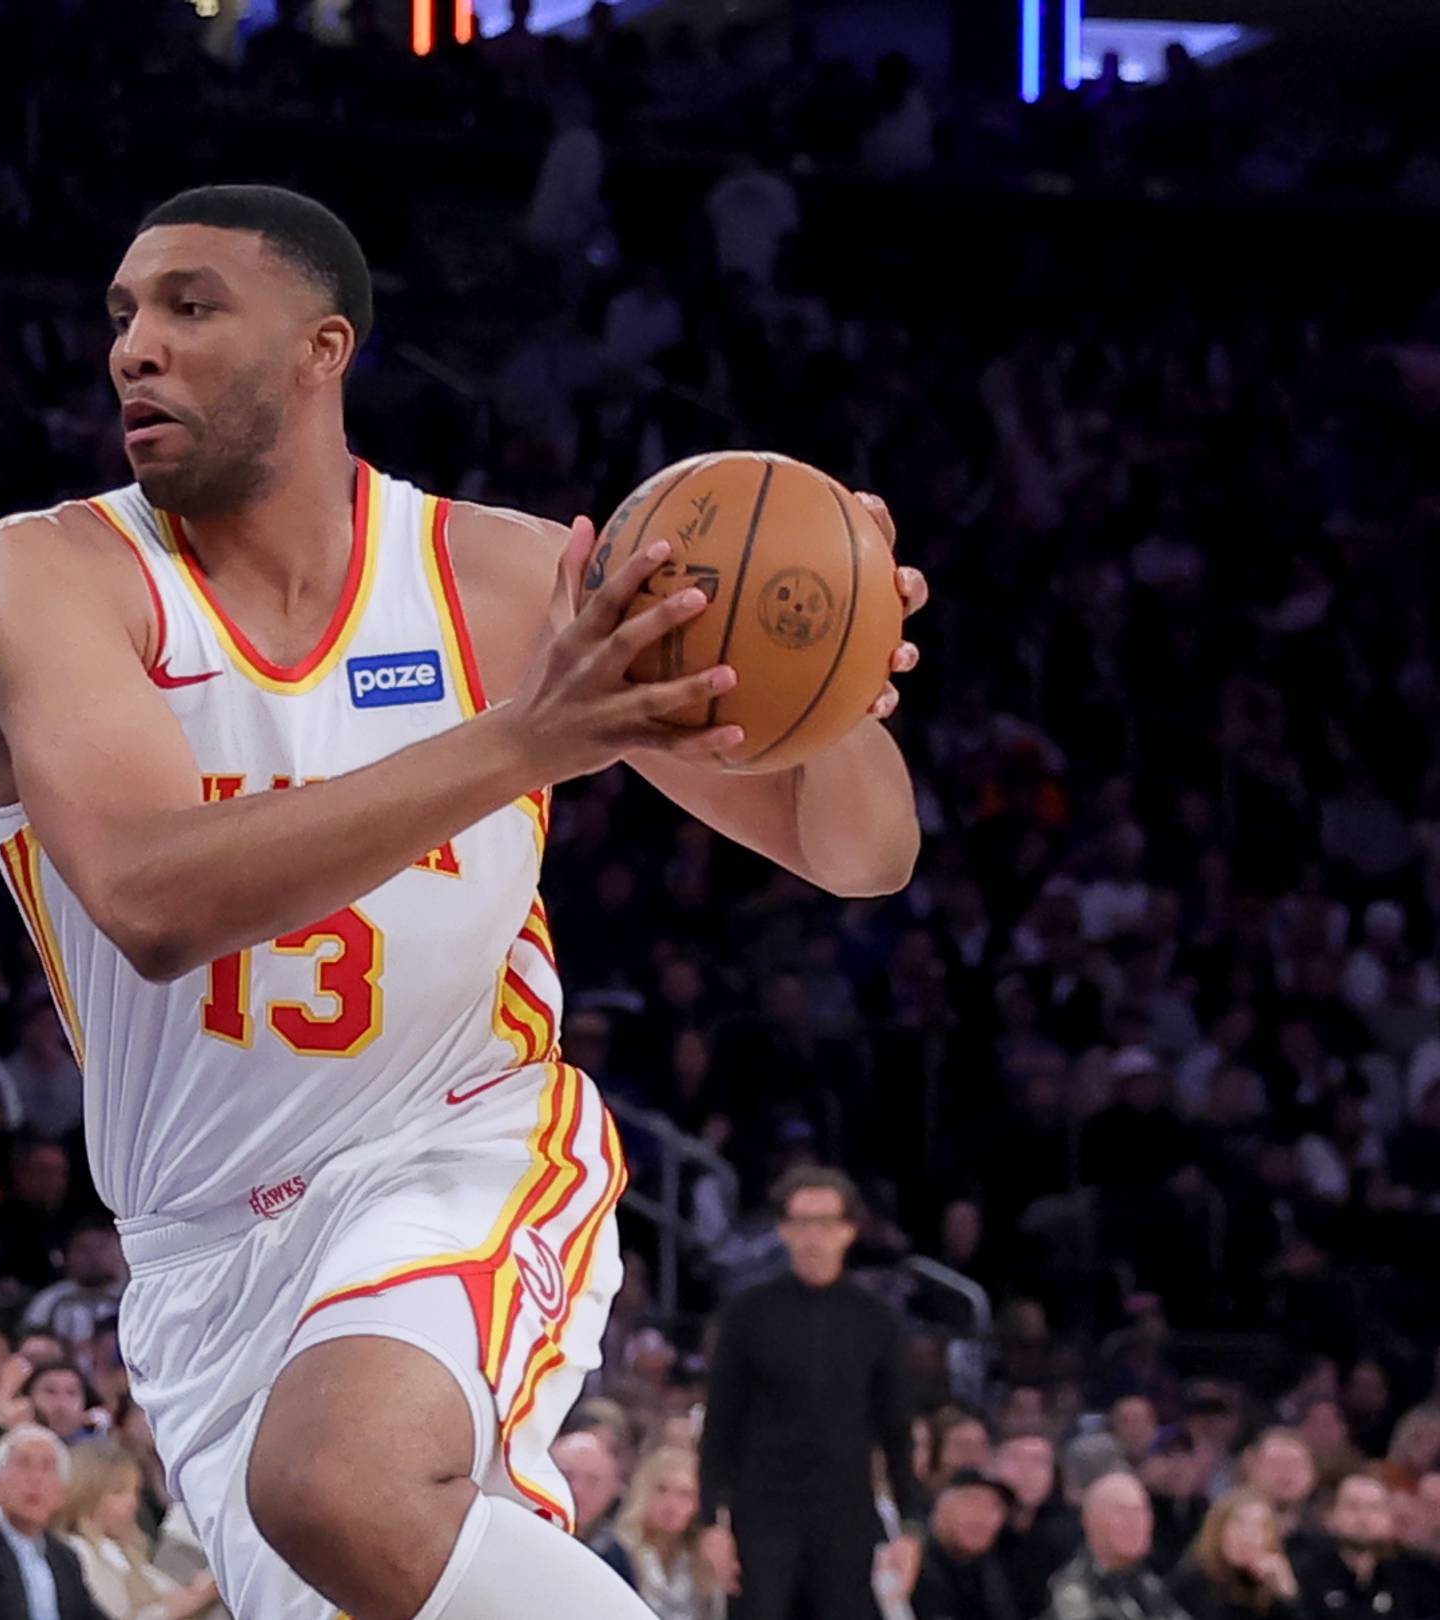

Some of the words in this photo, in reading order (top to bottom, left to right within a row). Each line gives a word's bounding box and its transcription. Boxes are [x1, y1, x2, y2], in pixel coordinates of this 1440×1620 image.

[354, 663, 436, 698] paze
[201, 903, 384, 1058] 13
[248, 1174, 306, 1218] HAWKS
